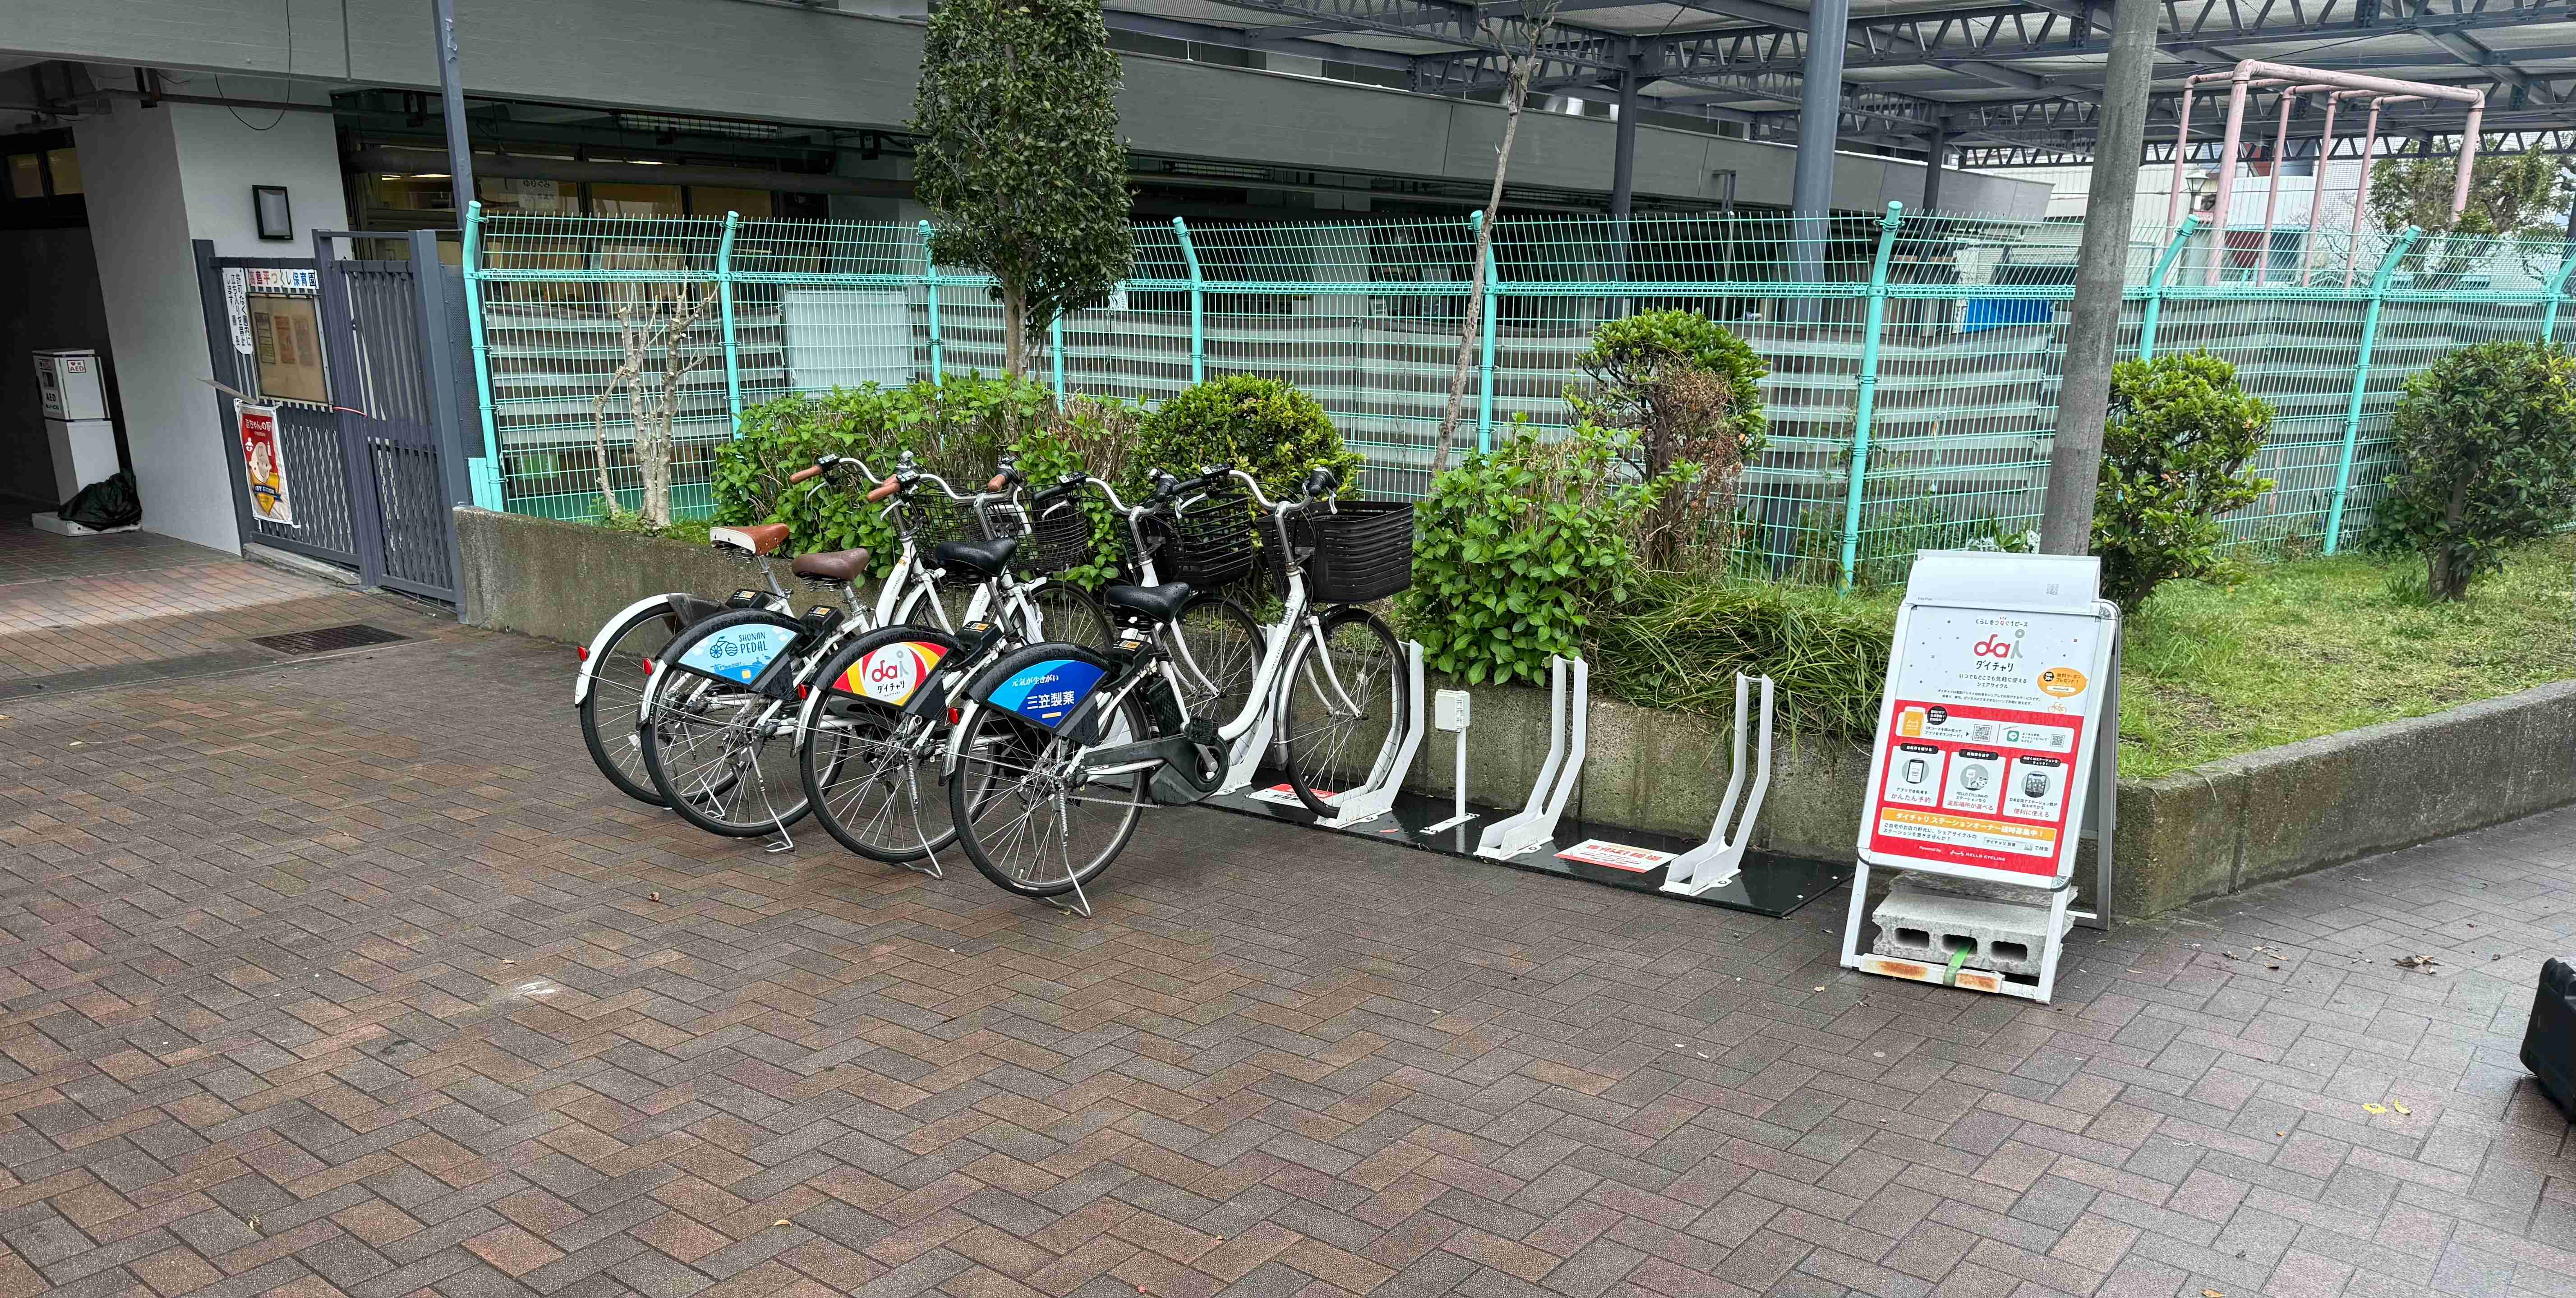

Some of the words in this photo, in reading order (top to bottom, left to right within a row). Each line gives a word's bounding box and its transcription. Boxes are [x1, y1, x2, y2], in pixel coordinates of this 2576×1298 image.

[46, 393, 56, 402] AED
[739, 631, 766, 643] SHONAN
[740, 640, 768, 654] PEDAL
[1973, 629, 2025, 659] dai
[871, 650, 909, 682] dai
[1976, 660, 2014, 672] ダイチャリ
[1012, 674, 1059, 687] 元気が生きがい
[1959, 674, 2027, 684] いつでもどこでも気軽に使える
[877, 680, 905, 694] ダイチャリ
[1027, 690, 1074, 709] 三笠製薬
[1891, 793, 1931, 803] かんたん予約
[1947, 801, 1993, 810] 返却場所が選べる
[1896, 812, 1929, 824] ダイチャリ
[2014, 808, 2050, 818] 便利に使える
